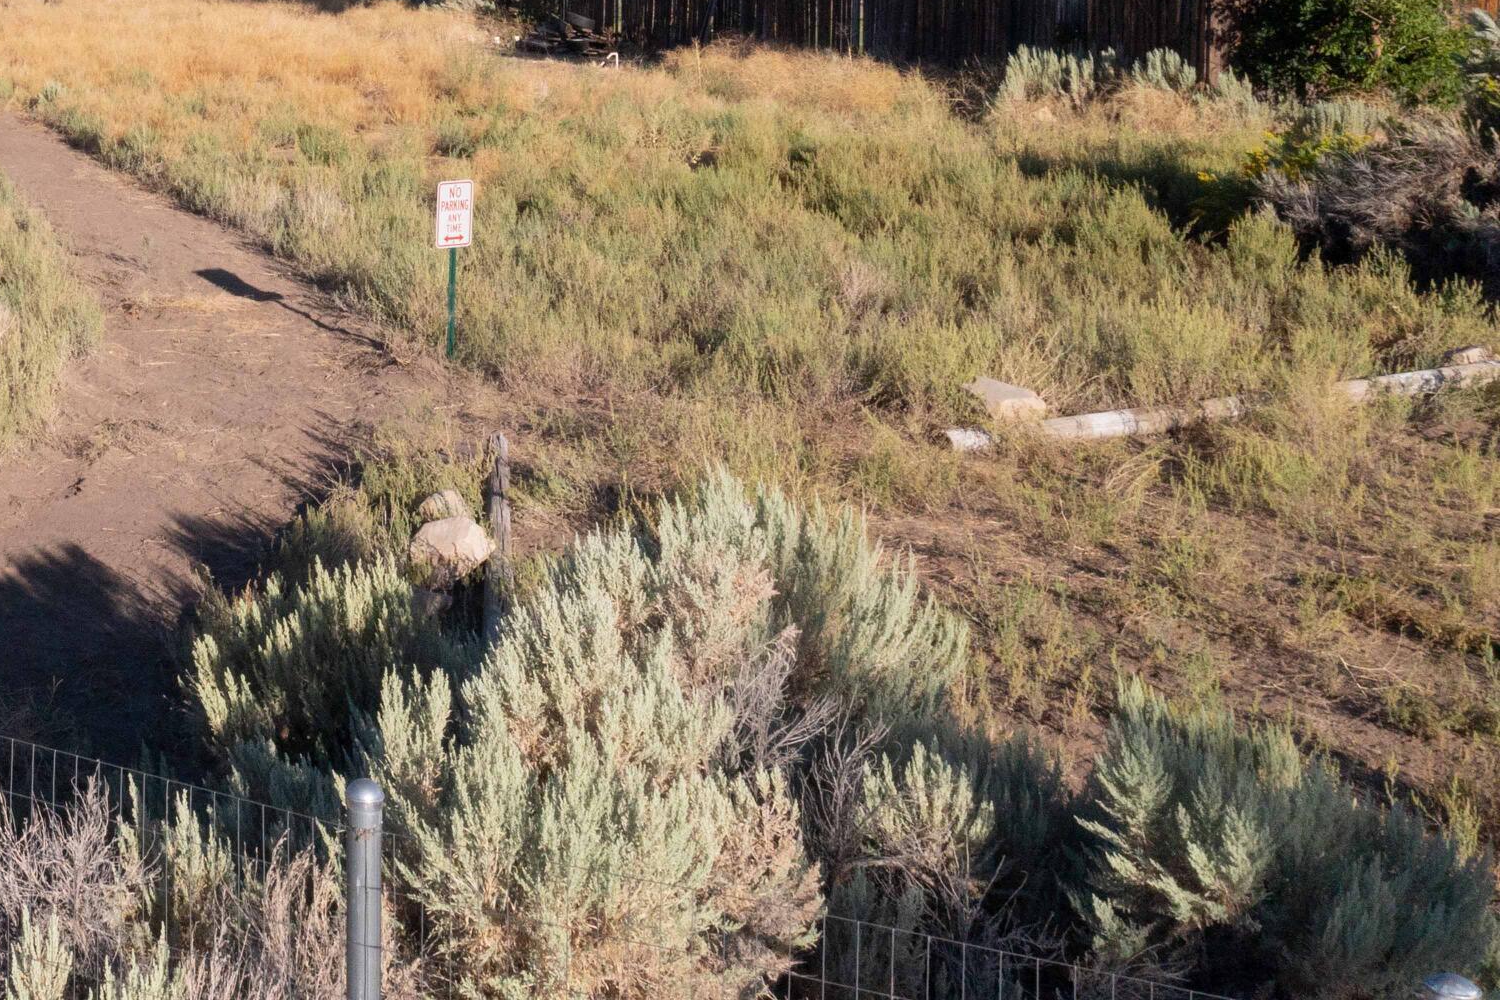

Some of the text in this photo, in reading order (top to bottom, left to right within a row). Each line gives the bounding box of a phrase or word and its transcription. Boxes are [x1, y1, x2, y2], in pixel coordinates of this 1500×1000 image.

[449, 187, 461, 198] NO
[441, 200, 468, 211] PARKING
[448, 213, 461, 221] ANY
[446, 223, 462, 232] TIME
